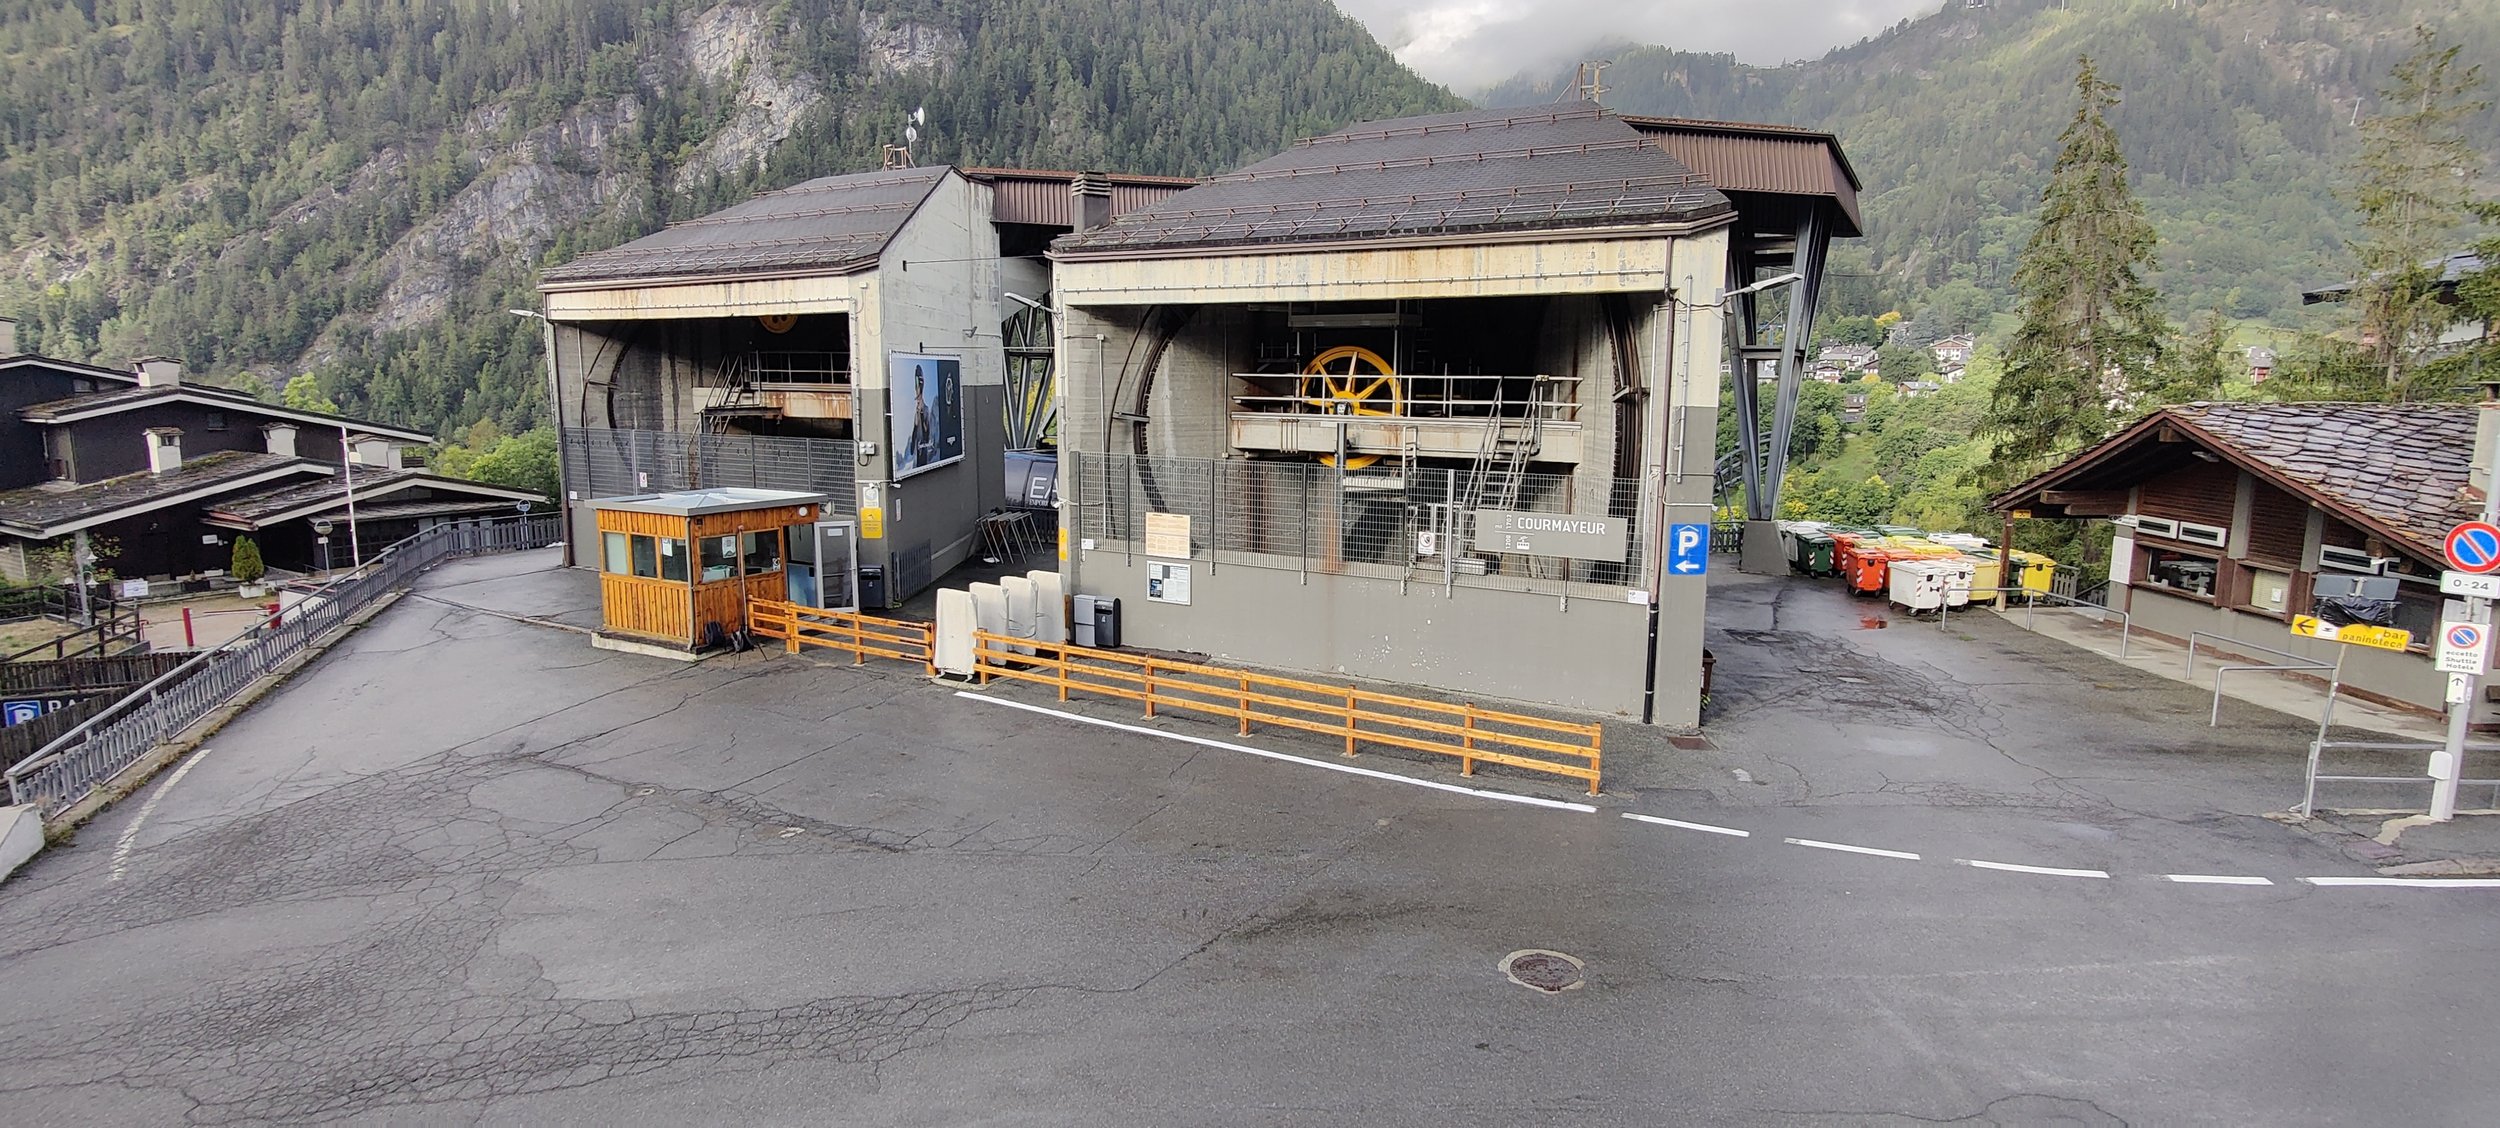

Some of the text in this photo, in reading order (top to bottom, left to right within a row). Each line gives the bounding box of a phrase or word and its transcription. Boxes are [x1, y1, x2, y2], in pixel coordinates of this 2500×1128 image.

[1517, 517, 1606, 535] COURMAYEUR
[1678, 531, 1699, 556] P
[2342, 633, 2403, 648] paninoteca
[2383, 629, 2406, 640] bar
[2445, 650, 2478, 658] eccetto
[2445, 656, 2477, 664] Shuttle
